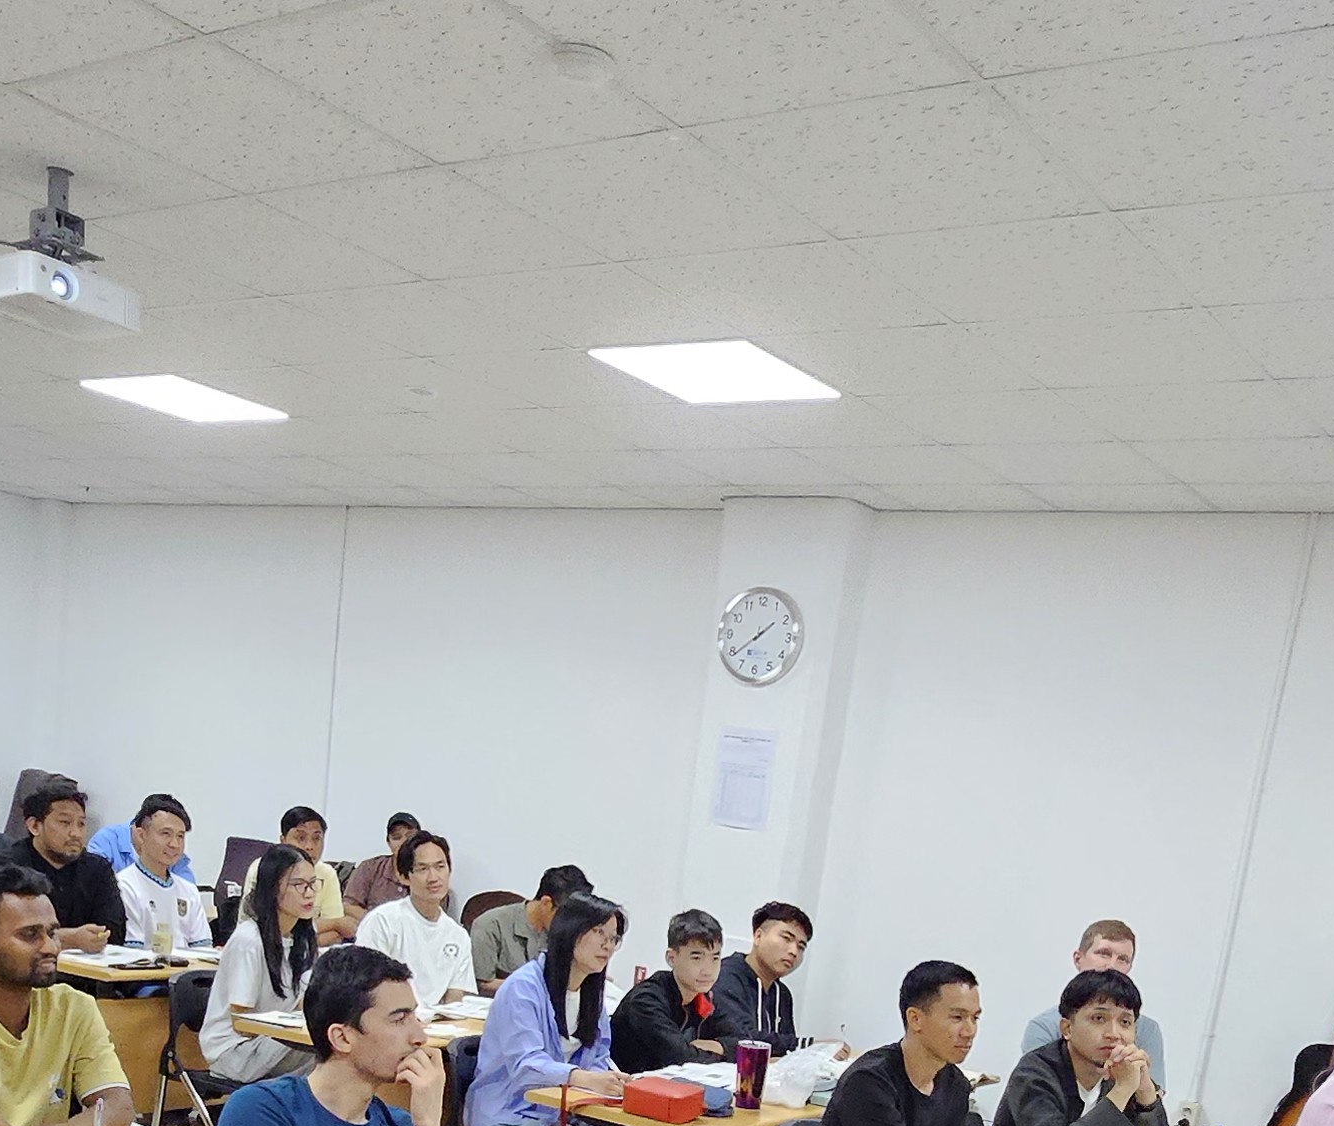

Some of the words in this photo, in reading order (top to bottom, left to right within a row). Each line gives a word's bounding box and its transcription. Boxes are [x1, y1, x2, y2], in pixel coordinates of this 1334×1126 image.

[745, 601, 753, 611] 11
[758, 596, 768, 607] 12
[782, 614, 790, 625] 2
[726, 628, 734, 640] 9
[785, 632, 792, 643] 3
[729, 646, 736, 657] 8
[778, 650, 785, 659] 4
[739, 659, 745, 669] 7
[751, 664, 758, 675] 6
[765, 661, 773, 672] 5
